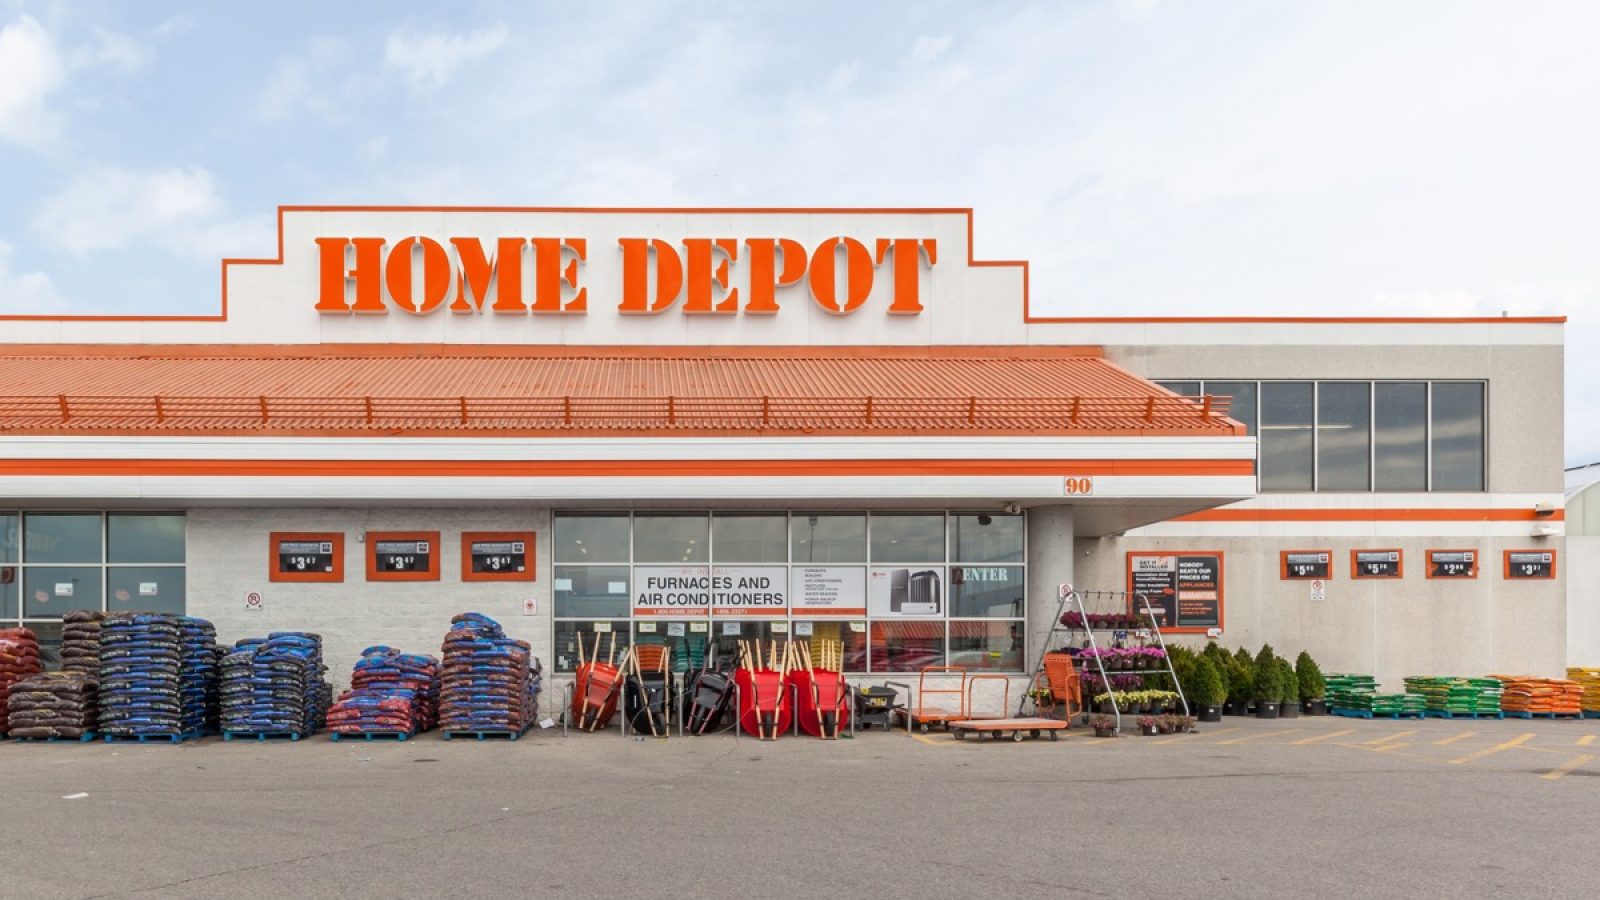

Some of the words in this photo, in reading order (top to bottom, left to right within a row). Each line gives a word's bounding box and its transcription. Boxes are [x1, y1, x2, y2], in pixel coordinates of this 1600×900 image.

[315, 236, 588, 314] HOME
[618, 237, 937, 315] DEPOT
[1066, 478, 1091, 493] 90
[963, 567, 1008, 581] ENTER
[647, 576, 733, 589] FURNACES
[738, 576, 771, 589] AND
[638, 592, 663, 606] AIR
[666, 592, 784, 606] CONDITIONERS
